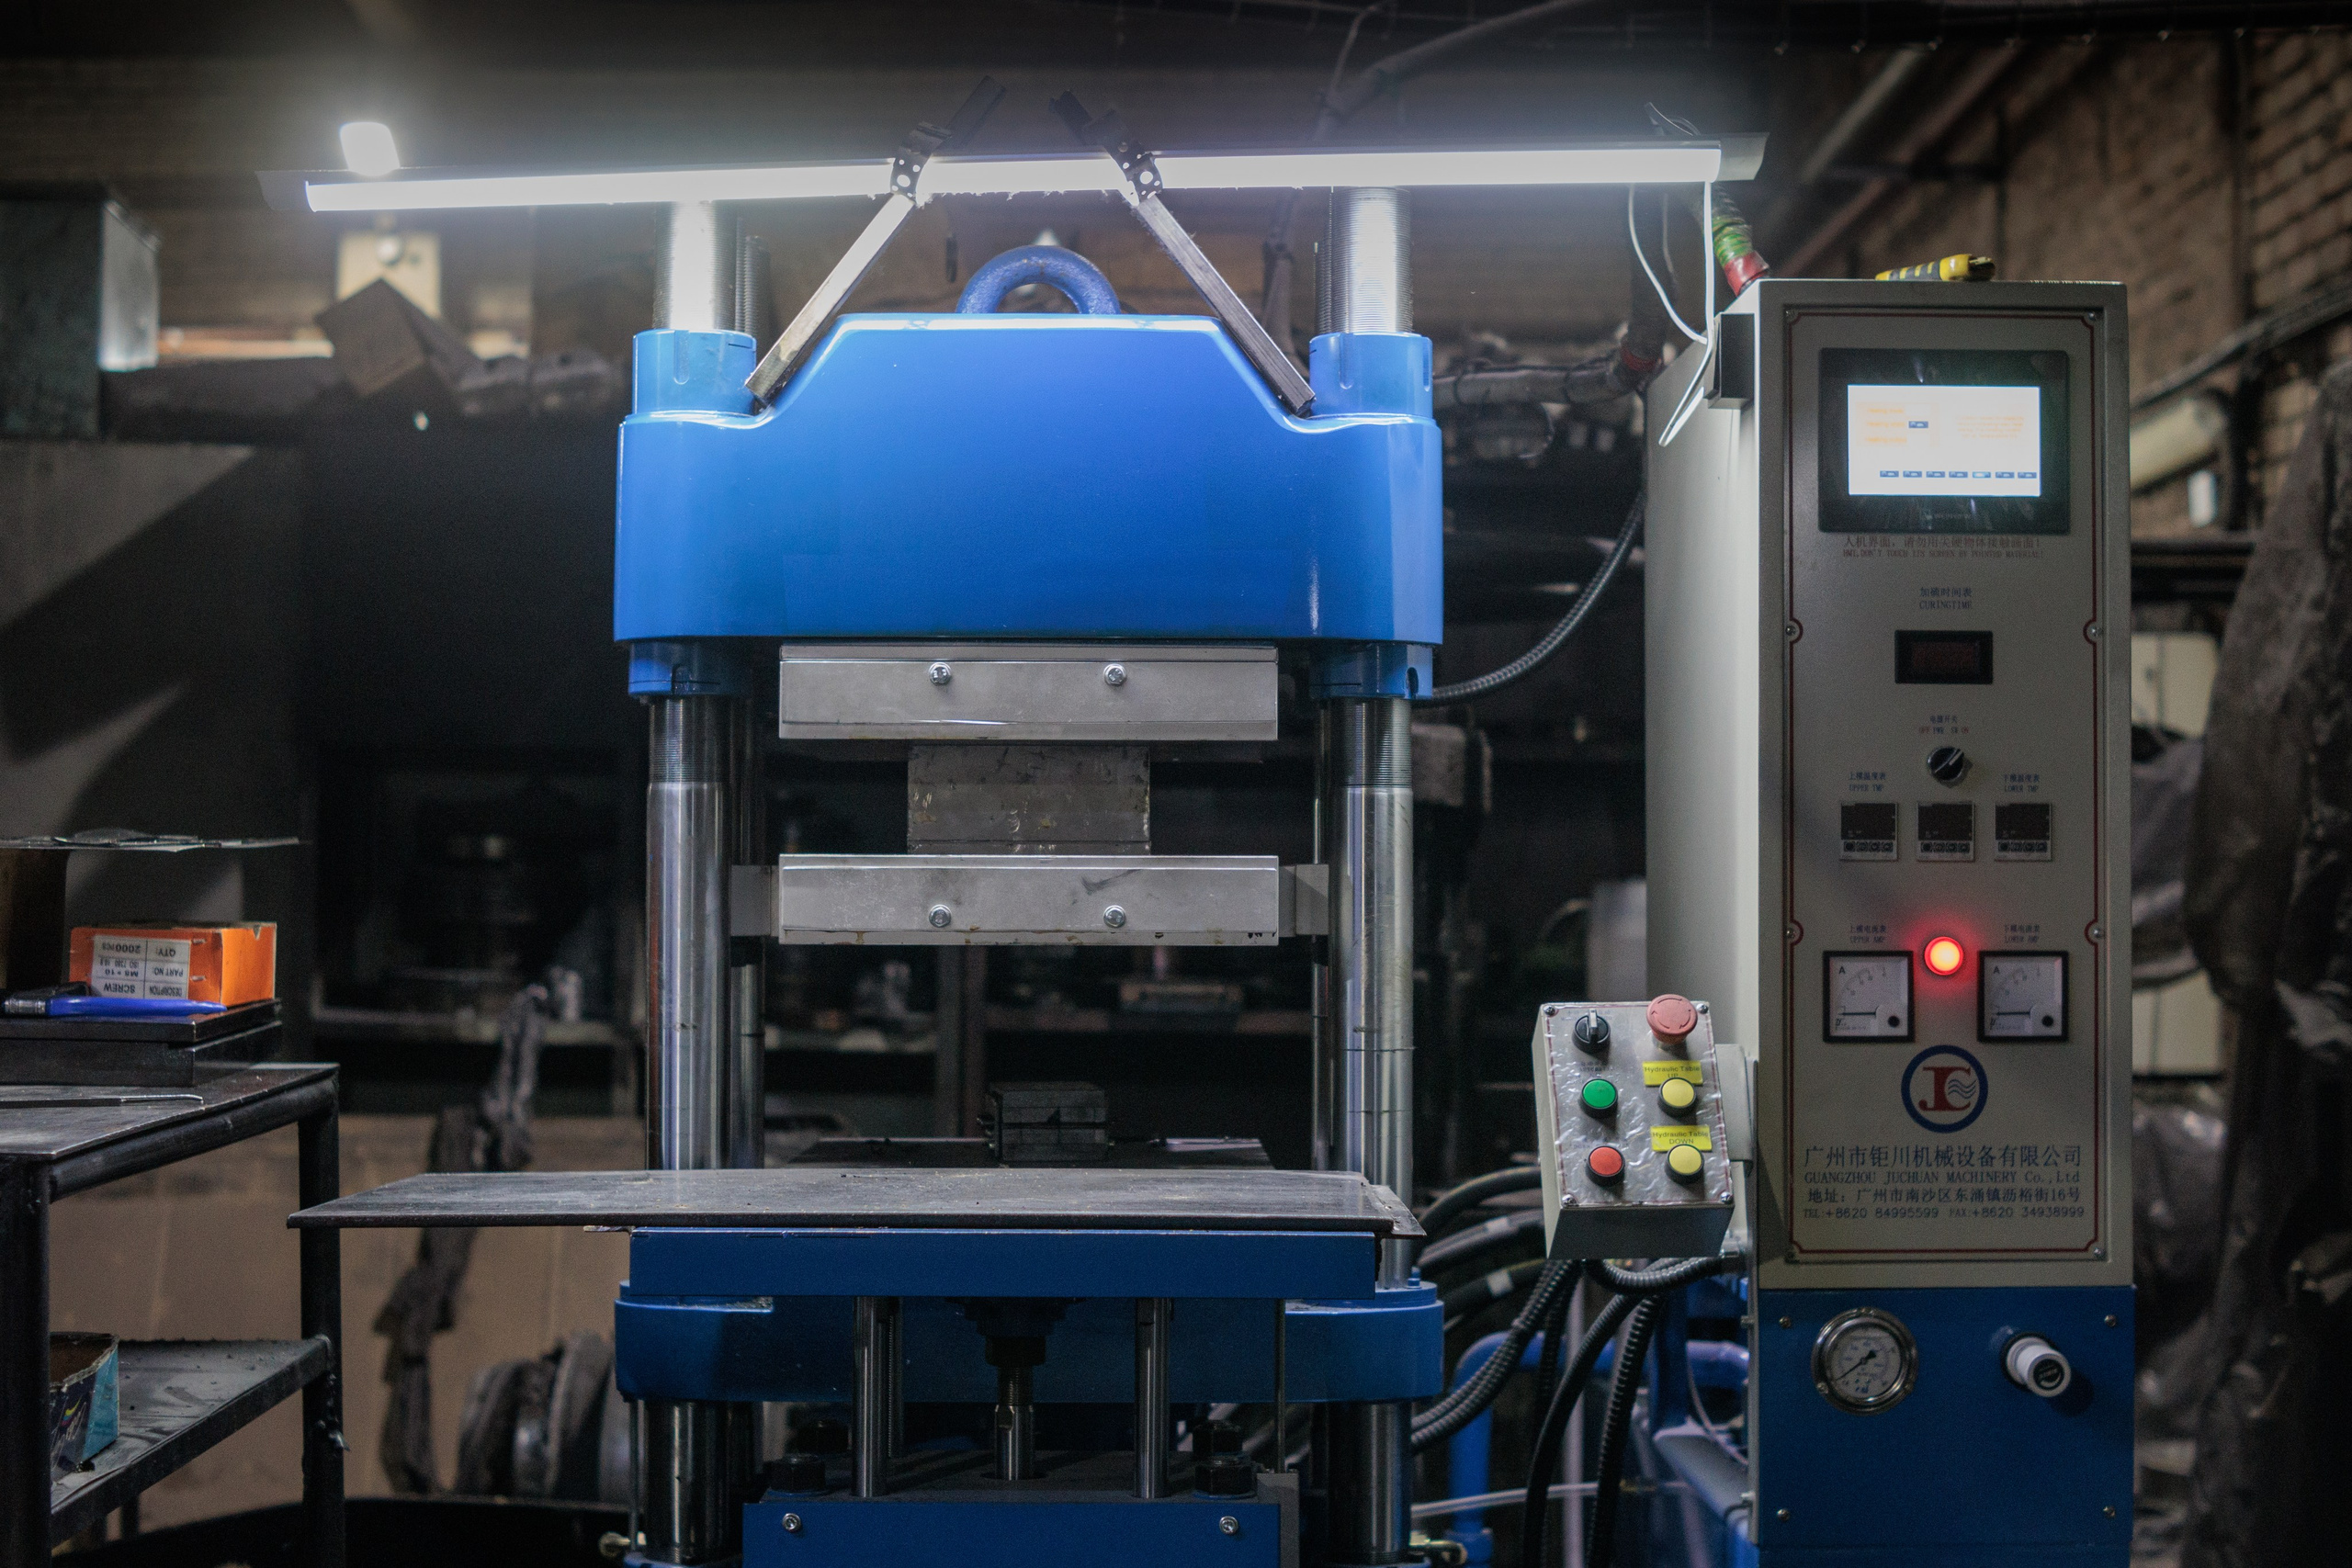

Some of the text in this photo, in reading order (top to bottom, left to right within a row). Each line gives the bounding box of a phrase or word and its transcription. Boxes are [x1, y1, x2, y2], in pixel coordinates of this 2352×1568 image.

[165, 967, 184, 977] PART
[1838, 965, 1846, 975] A
[1993, 965, 2000, 975] A
[103, 983, 136, 994] SCREW
[1645, 1066, 1679, 1074] Hydraulic
[1652, 1131, 1687, 1139] Hydraulic
[1804, 1145, 2082, 1168] 广州市钜川机械设备有限公司
[1804, 1171, 1876, 1184] GUANGZHOU
[1883, 1171, 1939, 1185] JUCHUAN
[1946, 1170, 2017, 1184] MACHINERY
[1875, 1207, 1939, 1219] 84995599
[2021, 1206, 2085, 1218] 34938999
